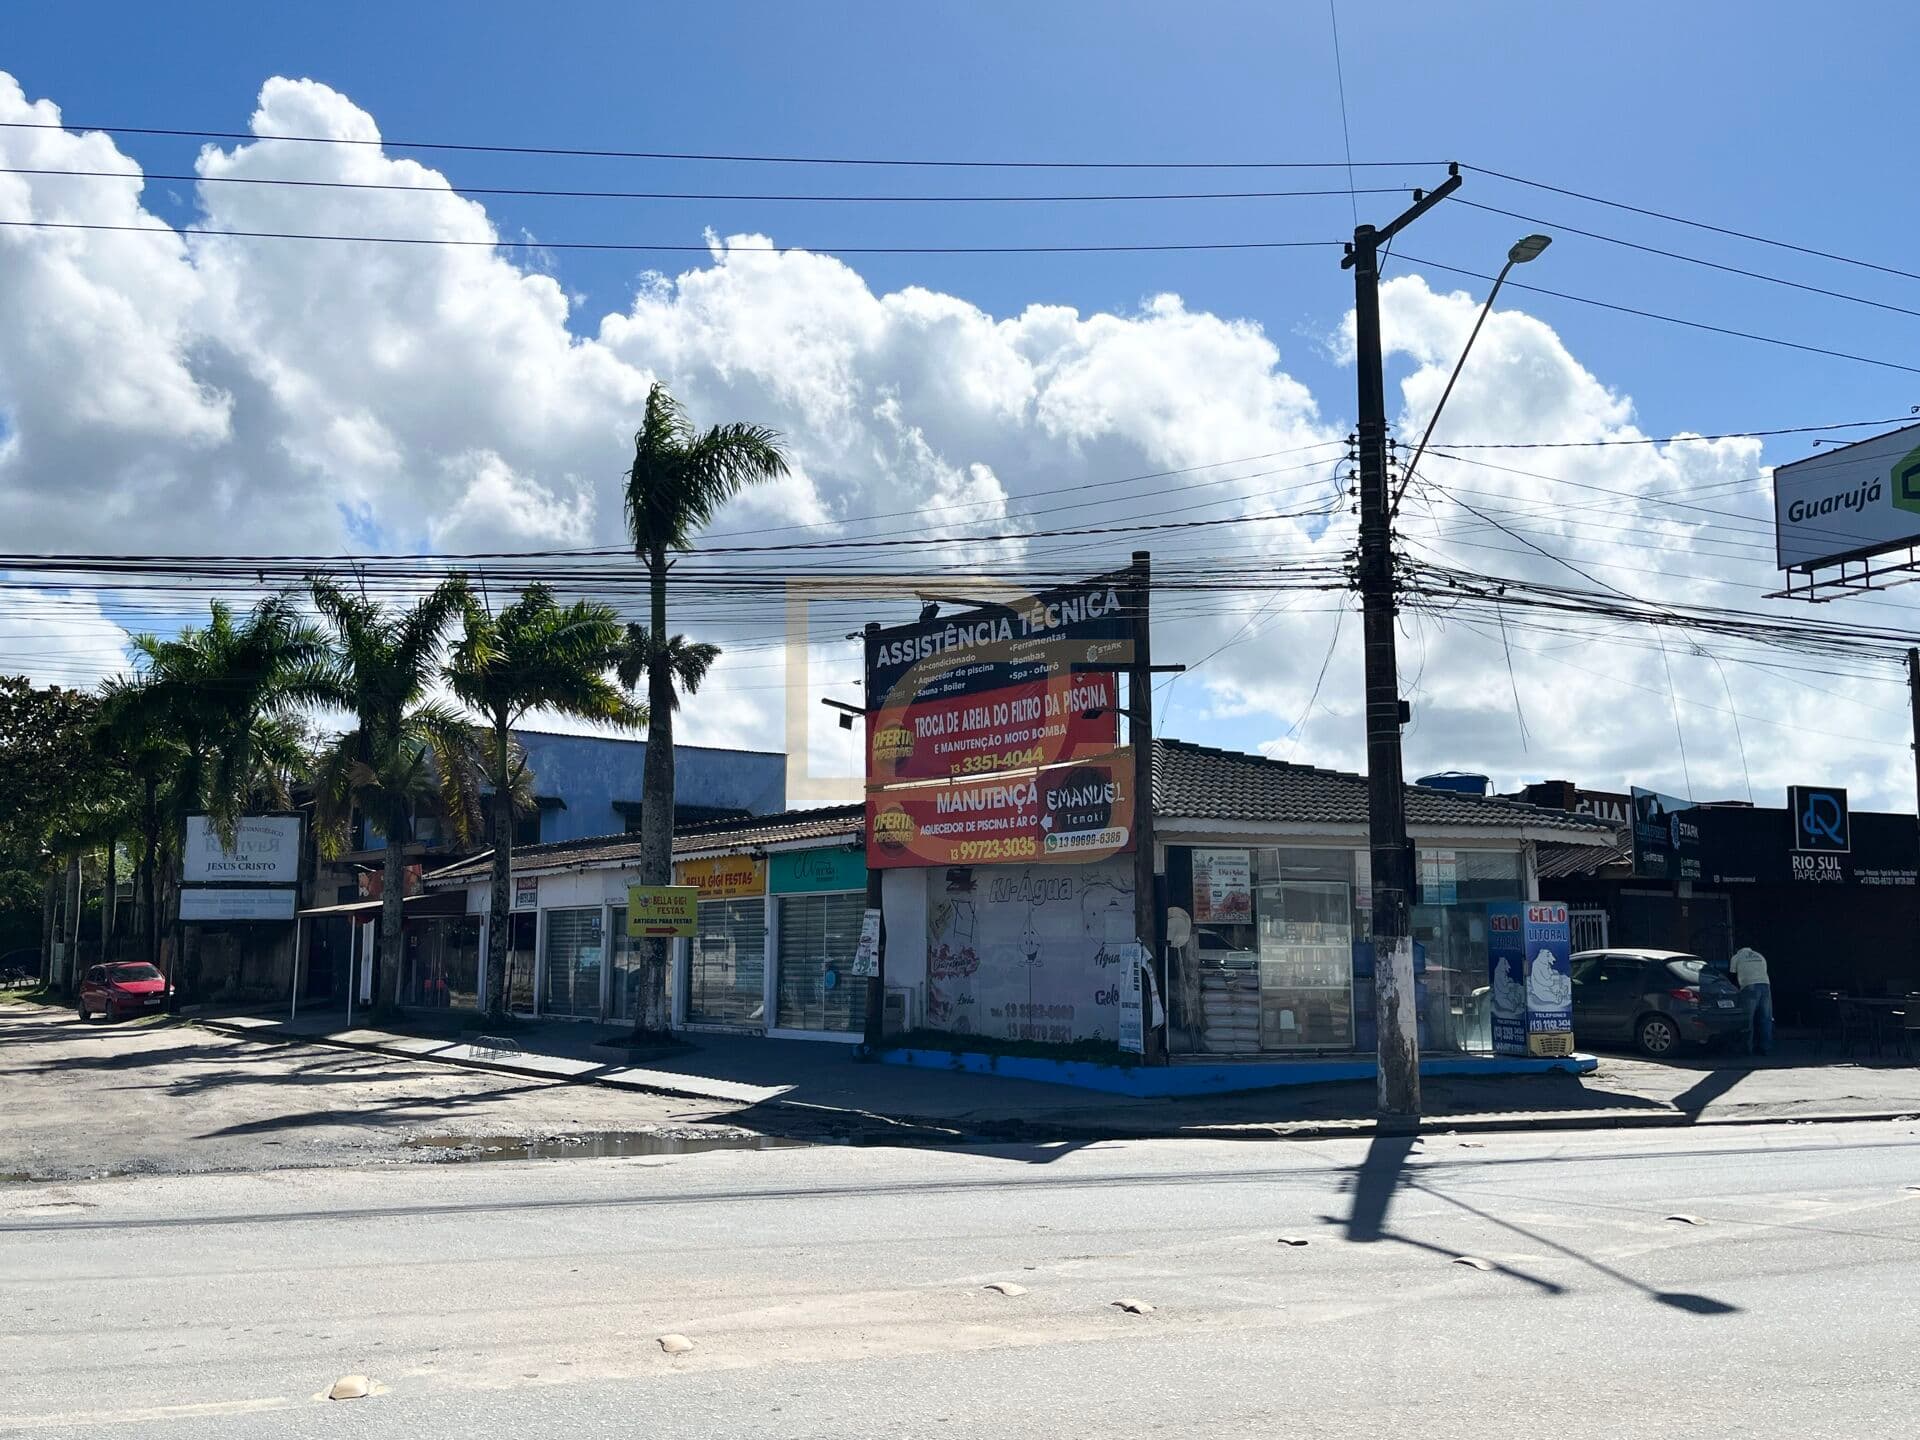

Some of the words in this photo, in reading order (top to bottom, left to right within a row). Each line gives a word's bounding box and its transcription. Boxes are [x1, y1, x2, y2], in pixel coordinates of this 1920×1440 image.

[1788, 477, 1882, 522] Guarujá
[877, 624, 1013, 668] ASSISTÊNCIA
[1018, 588, 1122, 635] TÉCNICA
[1012, 632, 1066, 652] Ferramentas
[1097, 641, 1122, 654] STARK
[1012, 651, 1046, 666] Bombas
[955, 668, 966, 678] de
[967, 663, 994, 677] piscina
[1012, 670, 1028, 681] Spa
[916, 686, 939, 697] Sauna
[915, 715, 945, 738] TROCA
[947, 715, 959, 733] DE
[962, 707, 991, 732] AREIA
[994, 703, 1008, 726] DO
[1011, 696, 1041, 723] FILTRO
[1045, 694, 1061, 717] DA
[1064, 683, 1107, 715] PISCINA
[934, 744, 939, 754] E
[940, 734, 1001, 753] MANUTENÇÃO
[1004, 730, 1029, 745] MOTO
[1032, 724, 1067, 739] BOMBA
[950, 764, 960, 774] 13
[962, 746, 1045, 772] 3351-4044
[1046, 782, 1126, 811] EMANUEL
[920, 823, 964, 836] AQUECEDOR
[966, 821, 976, 832] DE
[977, 818, 1008, 831] PISCINA
[1010, 817, 1014, 828] E
[1016, 815, 1028, 828] AR
[1066, 811, 1104, 825] Temaki
[1679, 823, 1699, 839] STARK
[950, 848, 959, 861] 13
[960, 836, 1036, 860] 99723-3035
[1059, 836, 1069, 848] 13
[205, 862, 236, 873] JESUS
[238, 862, 276, 871] CRISTO
[1792, 855, 1815, 869] RIO
[1818, 856, 1841, 870] SUL
[686, 875, 706, 888] BELLA
[708, 874, 723, 887] GIGI
[725, 872, 753, 886] FESTAS
[1793, 869, 1842, 883] TAPEÇARIA
[652, 895, 672, 905] BELLA
[673, 896, 687, 905] GIGI
[657, 907, 685, 915] FESTAS
[1528, 906, 1566, 923] GELO
[1491, 914, 1520, 931] GELO
[1528, 928, 1568, 942] LITORAL
[1094, 984, 1120, 1006] Gelo
